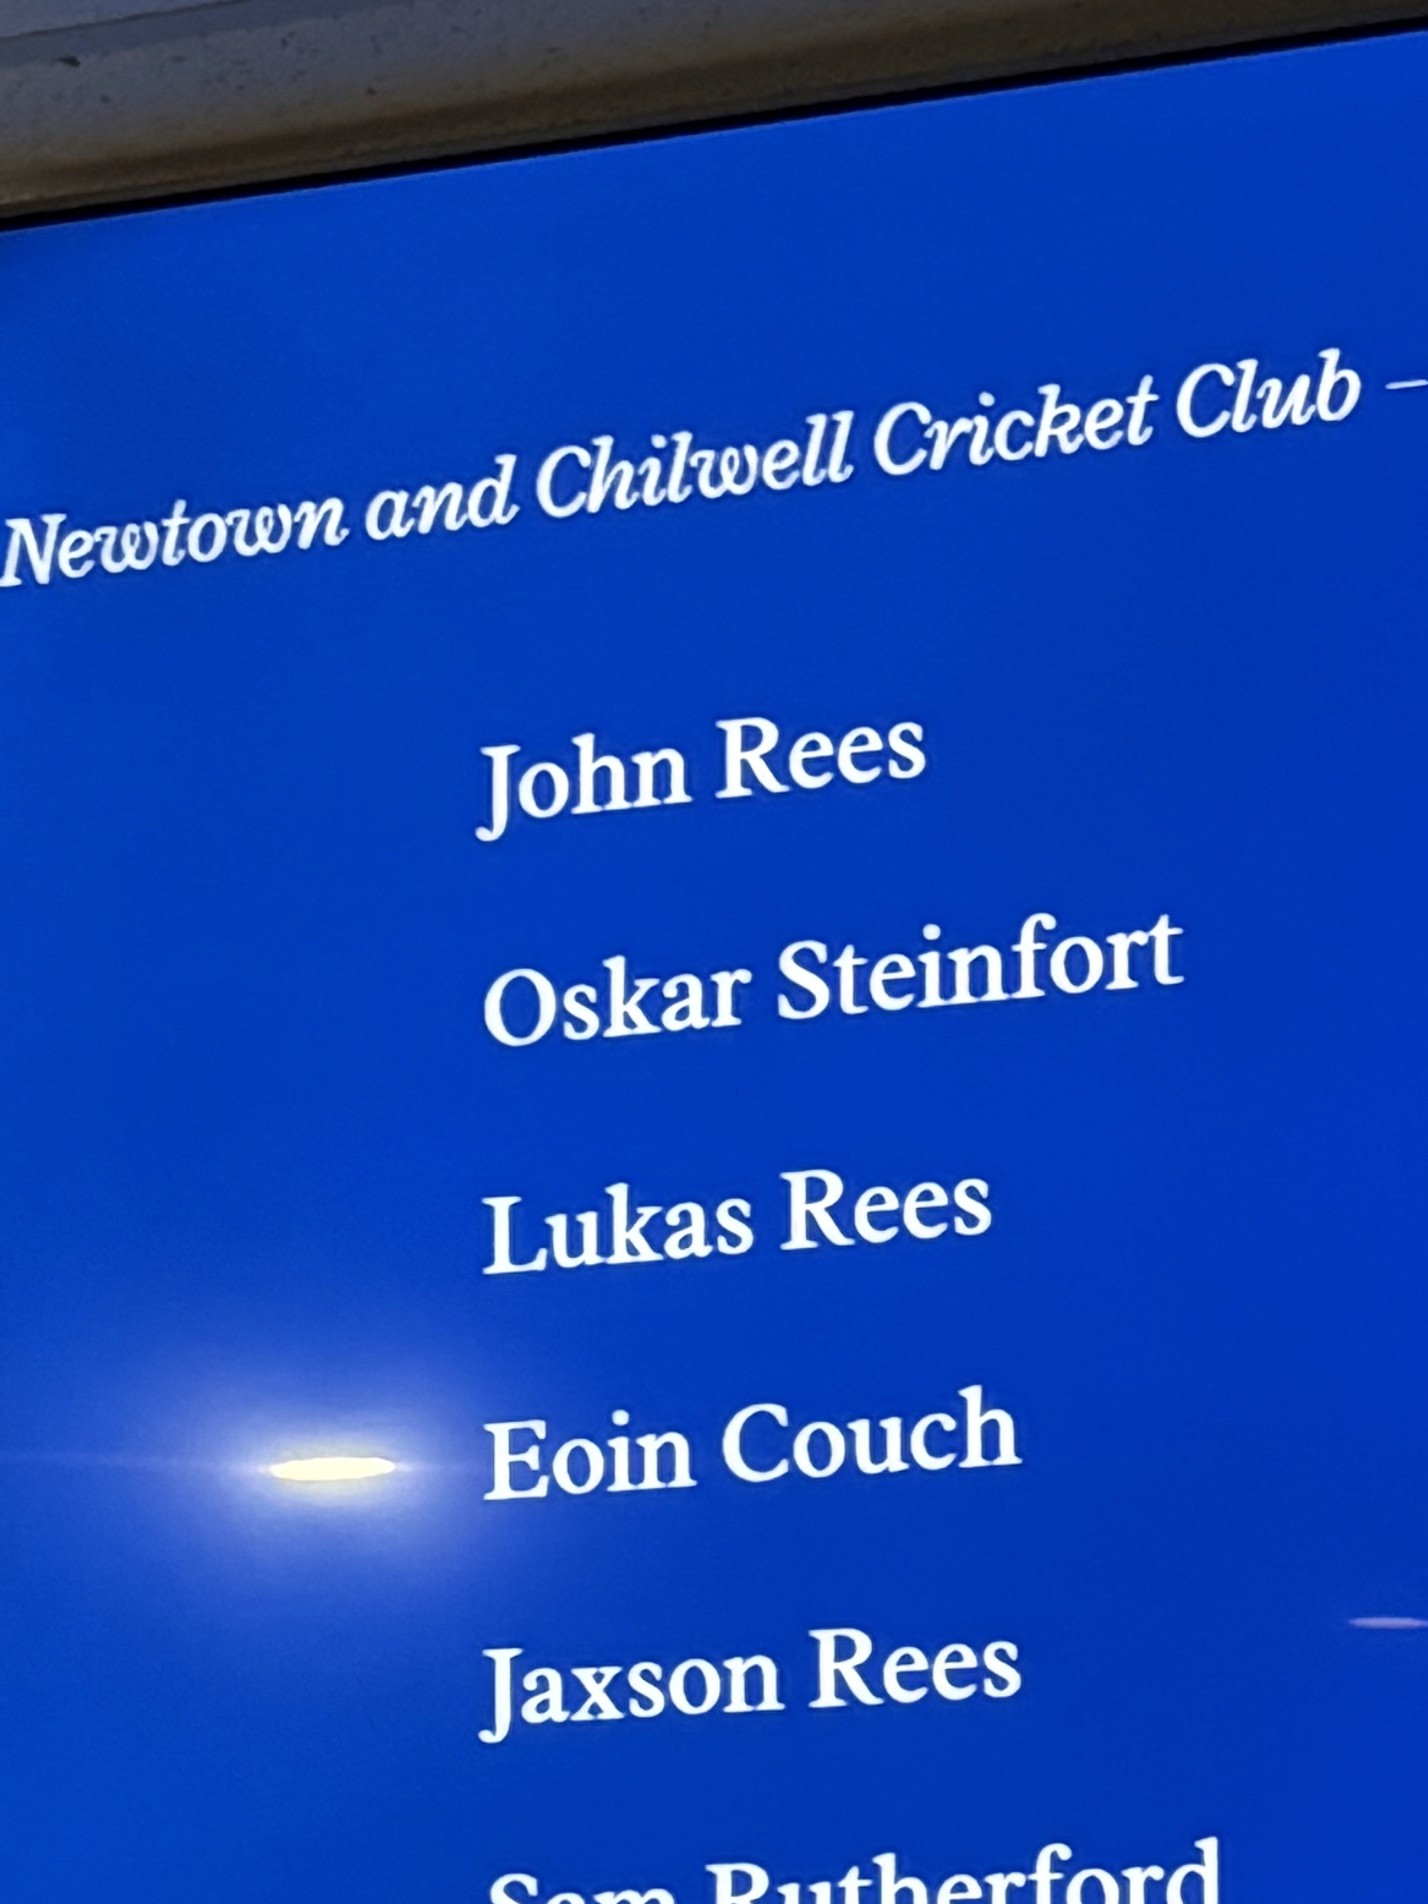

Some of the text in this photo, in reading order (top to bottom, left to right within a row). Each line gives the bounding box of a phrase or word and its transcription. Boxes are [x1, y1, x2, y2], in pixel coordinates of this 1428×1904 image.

[0, 497, 349, 587] Newtown
[366, 454, 519, 541] and
[537, 411, 853, 518] Chilwell
[874, 376, 1158, 476] Cricket
[1177, 348, 1361, 437] Club
[476, 717, 925, 842] John Rees
[484, 912, 1183, 1047] Oskar Steinfort
[483, 1169, 991, 1275] Lukas Rees
[483, 1384, 1022, 1501] Eoin Couch
[478, 1628, 1022, 1744] Jaxson Rees
